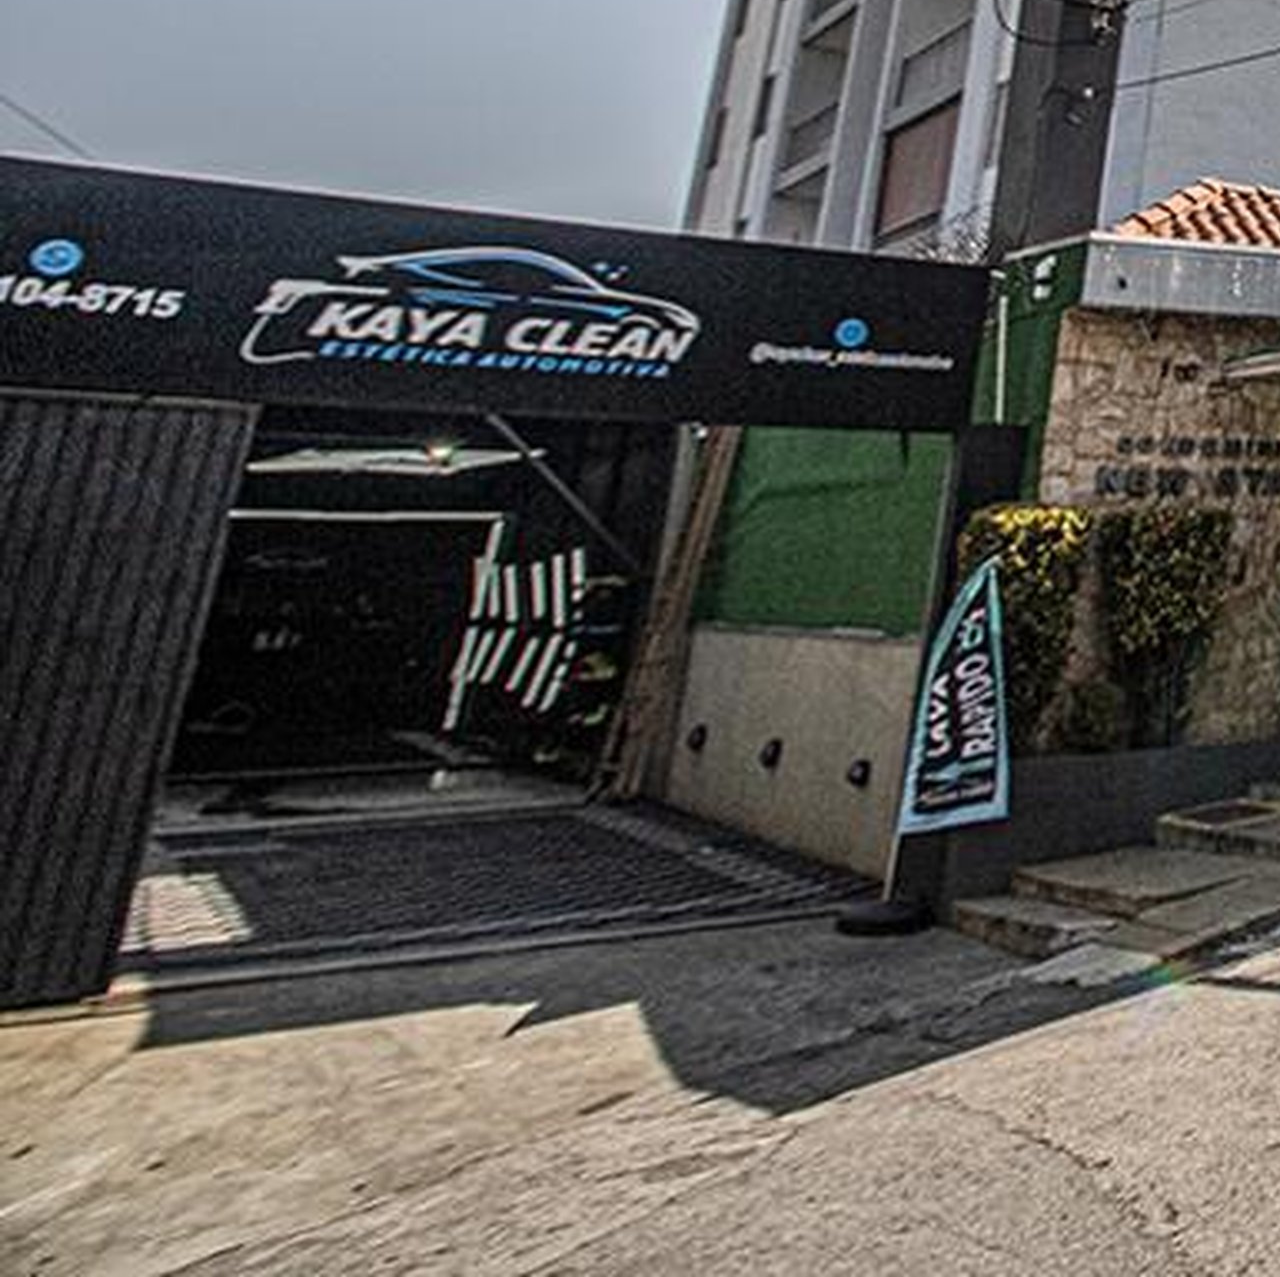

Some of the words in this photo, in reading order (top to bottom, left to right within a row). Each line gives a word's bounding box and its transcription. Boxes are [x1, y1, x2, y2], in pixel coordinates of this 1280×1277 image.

[308, 302, 488, 348] KAYA
[504, 318, 697, 363] CLEAN
[476, 352, 670, 378] AUTOMOTIVA
[927, 675, 951, 758] LAVA
